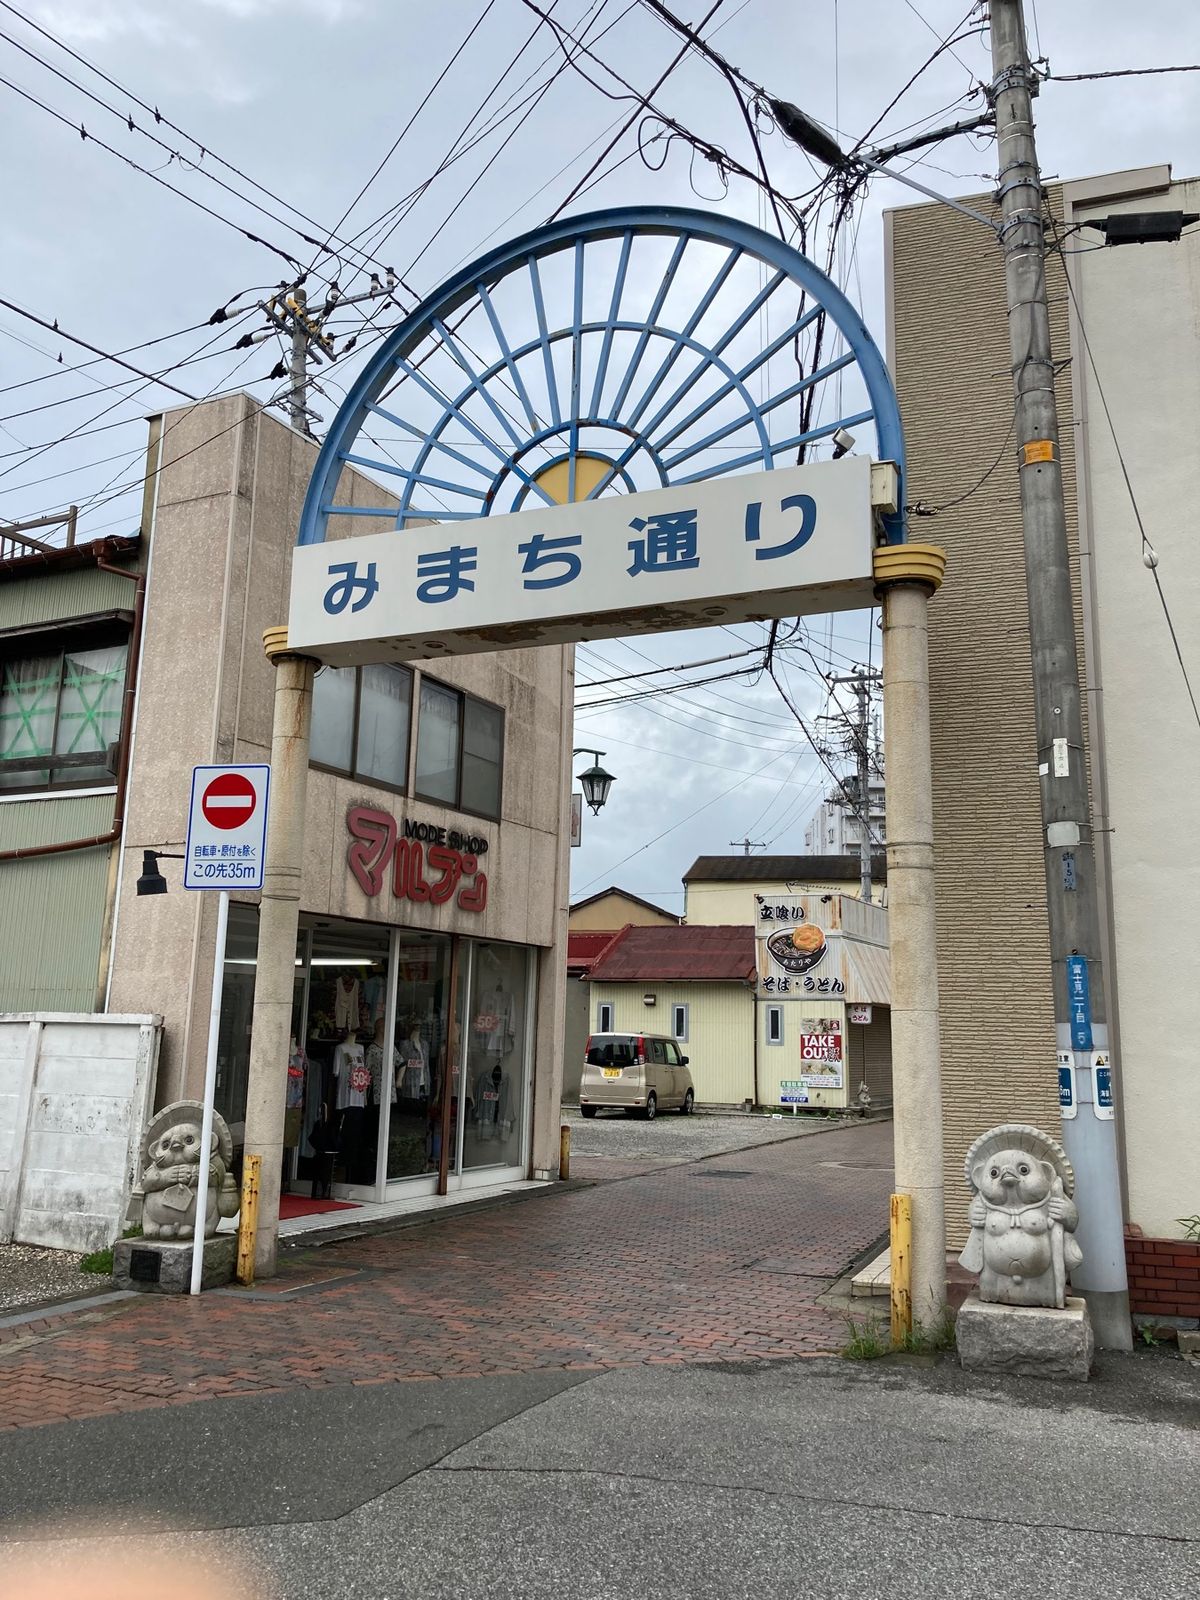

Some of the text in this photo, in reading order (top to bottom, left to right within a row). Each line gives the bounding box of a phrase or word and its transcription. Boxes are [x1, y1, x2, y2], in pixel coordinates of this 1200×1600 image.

[323, 493, 818, 616] みまち通り
[405, 819, 489, 855] MODE SHOP
[194, 844, 256, 857] 自転車・原付を除く
[193, 863, 255, 879] この先35m
[760, 905, 805, 920] 立喰い
[763, 976, 845, 993] そば・うどん
[1072, 964, 1085, 1023] 富士見一丁目
[802, 1035, 835, 1047] TAKE
[803, 1047, 829, 1059] OUT
